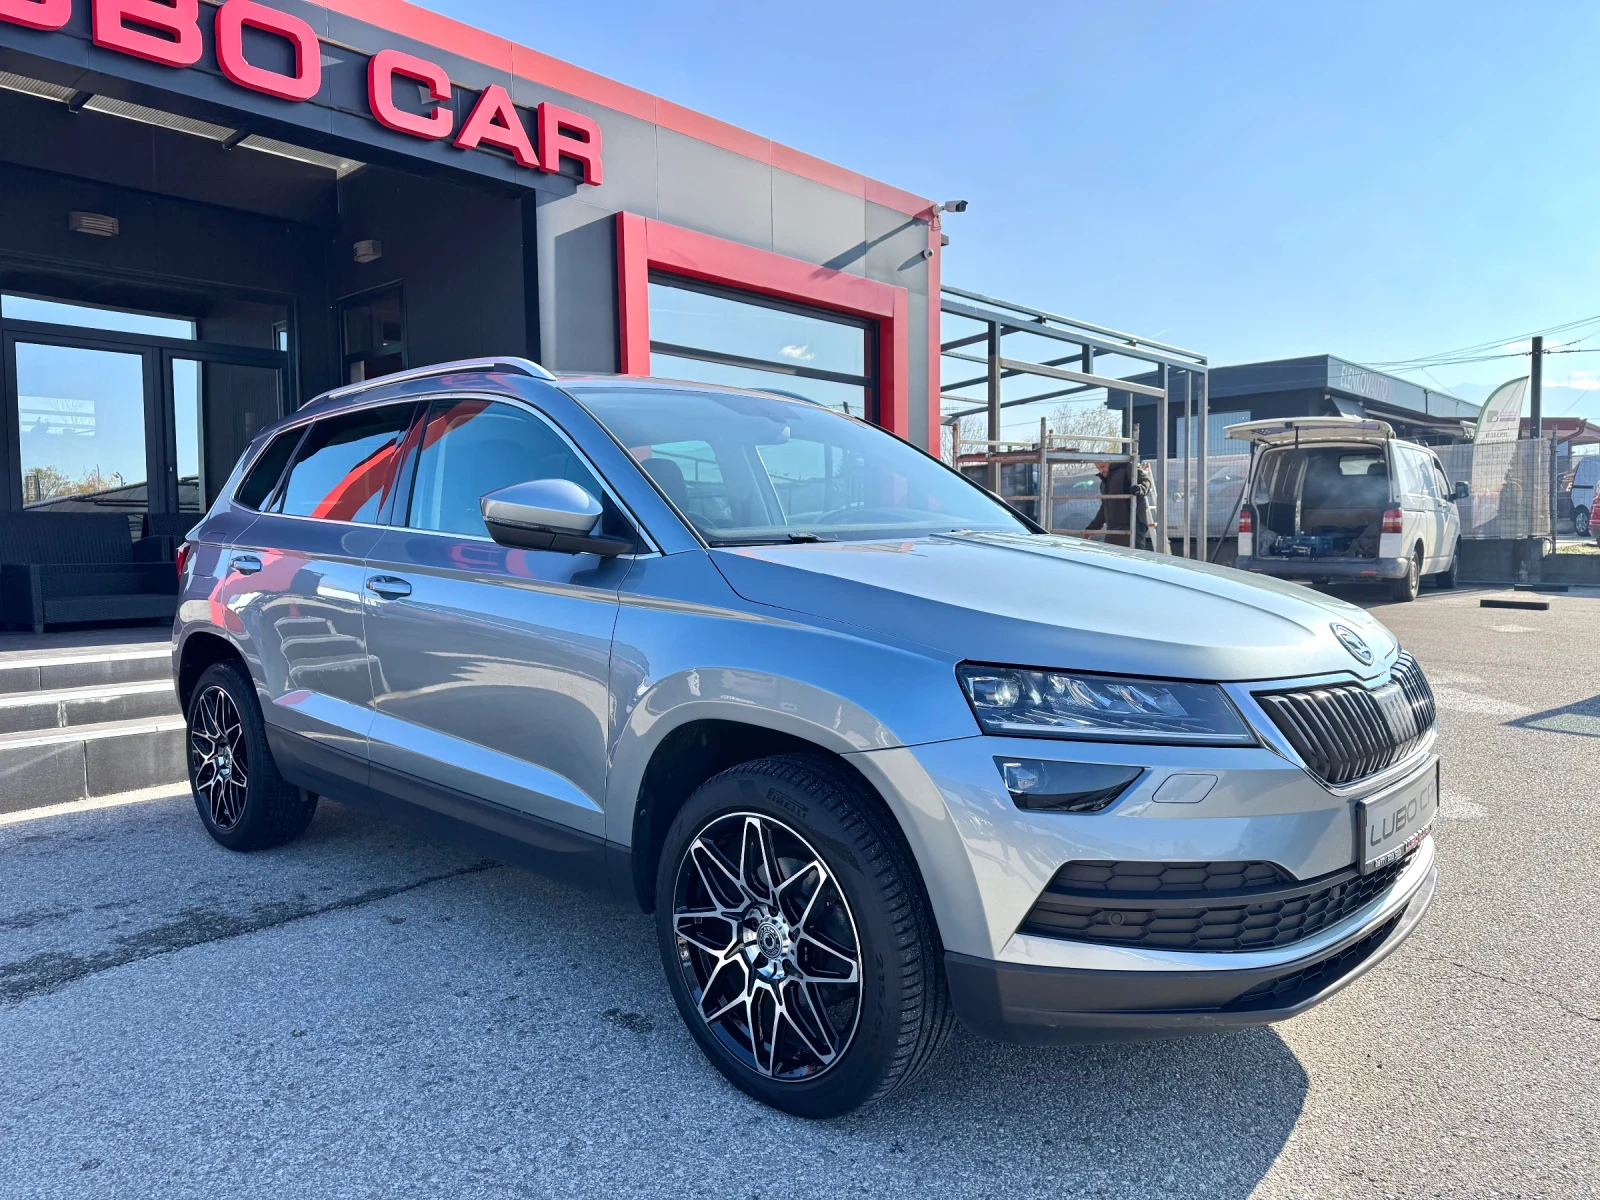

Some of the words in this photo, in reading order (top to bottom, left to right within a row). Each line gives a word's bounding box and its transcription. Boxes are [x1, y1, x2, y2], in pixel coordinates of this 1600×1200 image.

[368, 49, 603, 187] CAR
[766, 787, 809, 819] PIRELLI
[1370, 796, 1417, 847] LUBO
